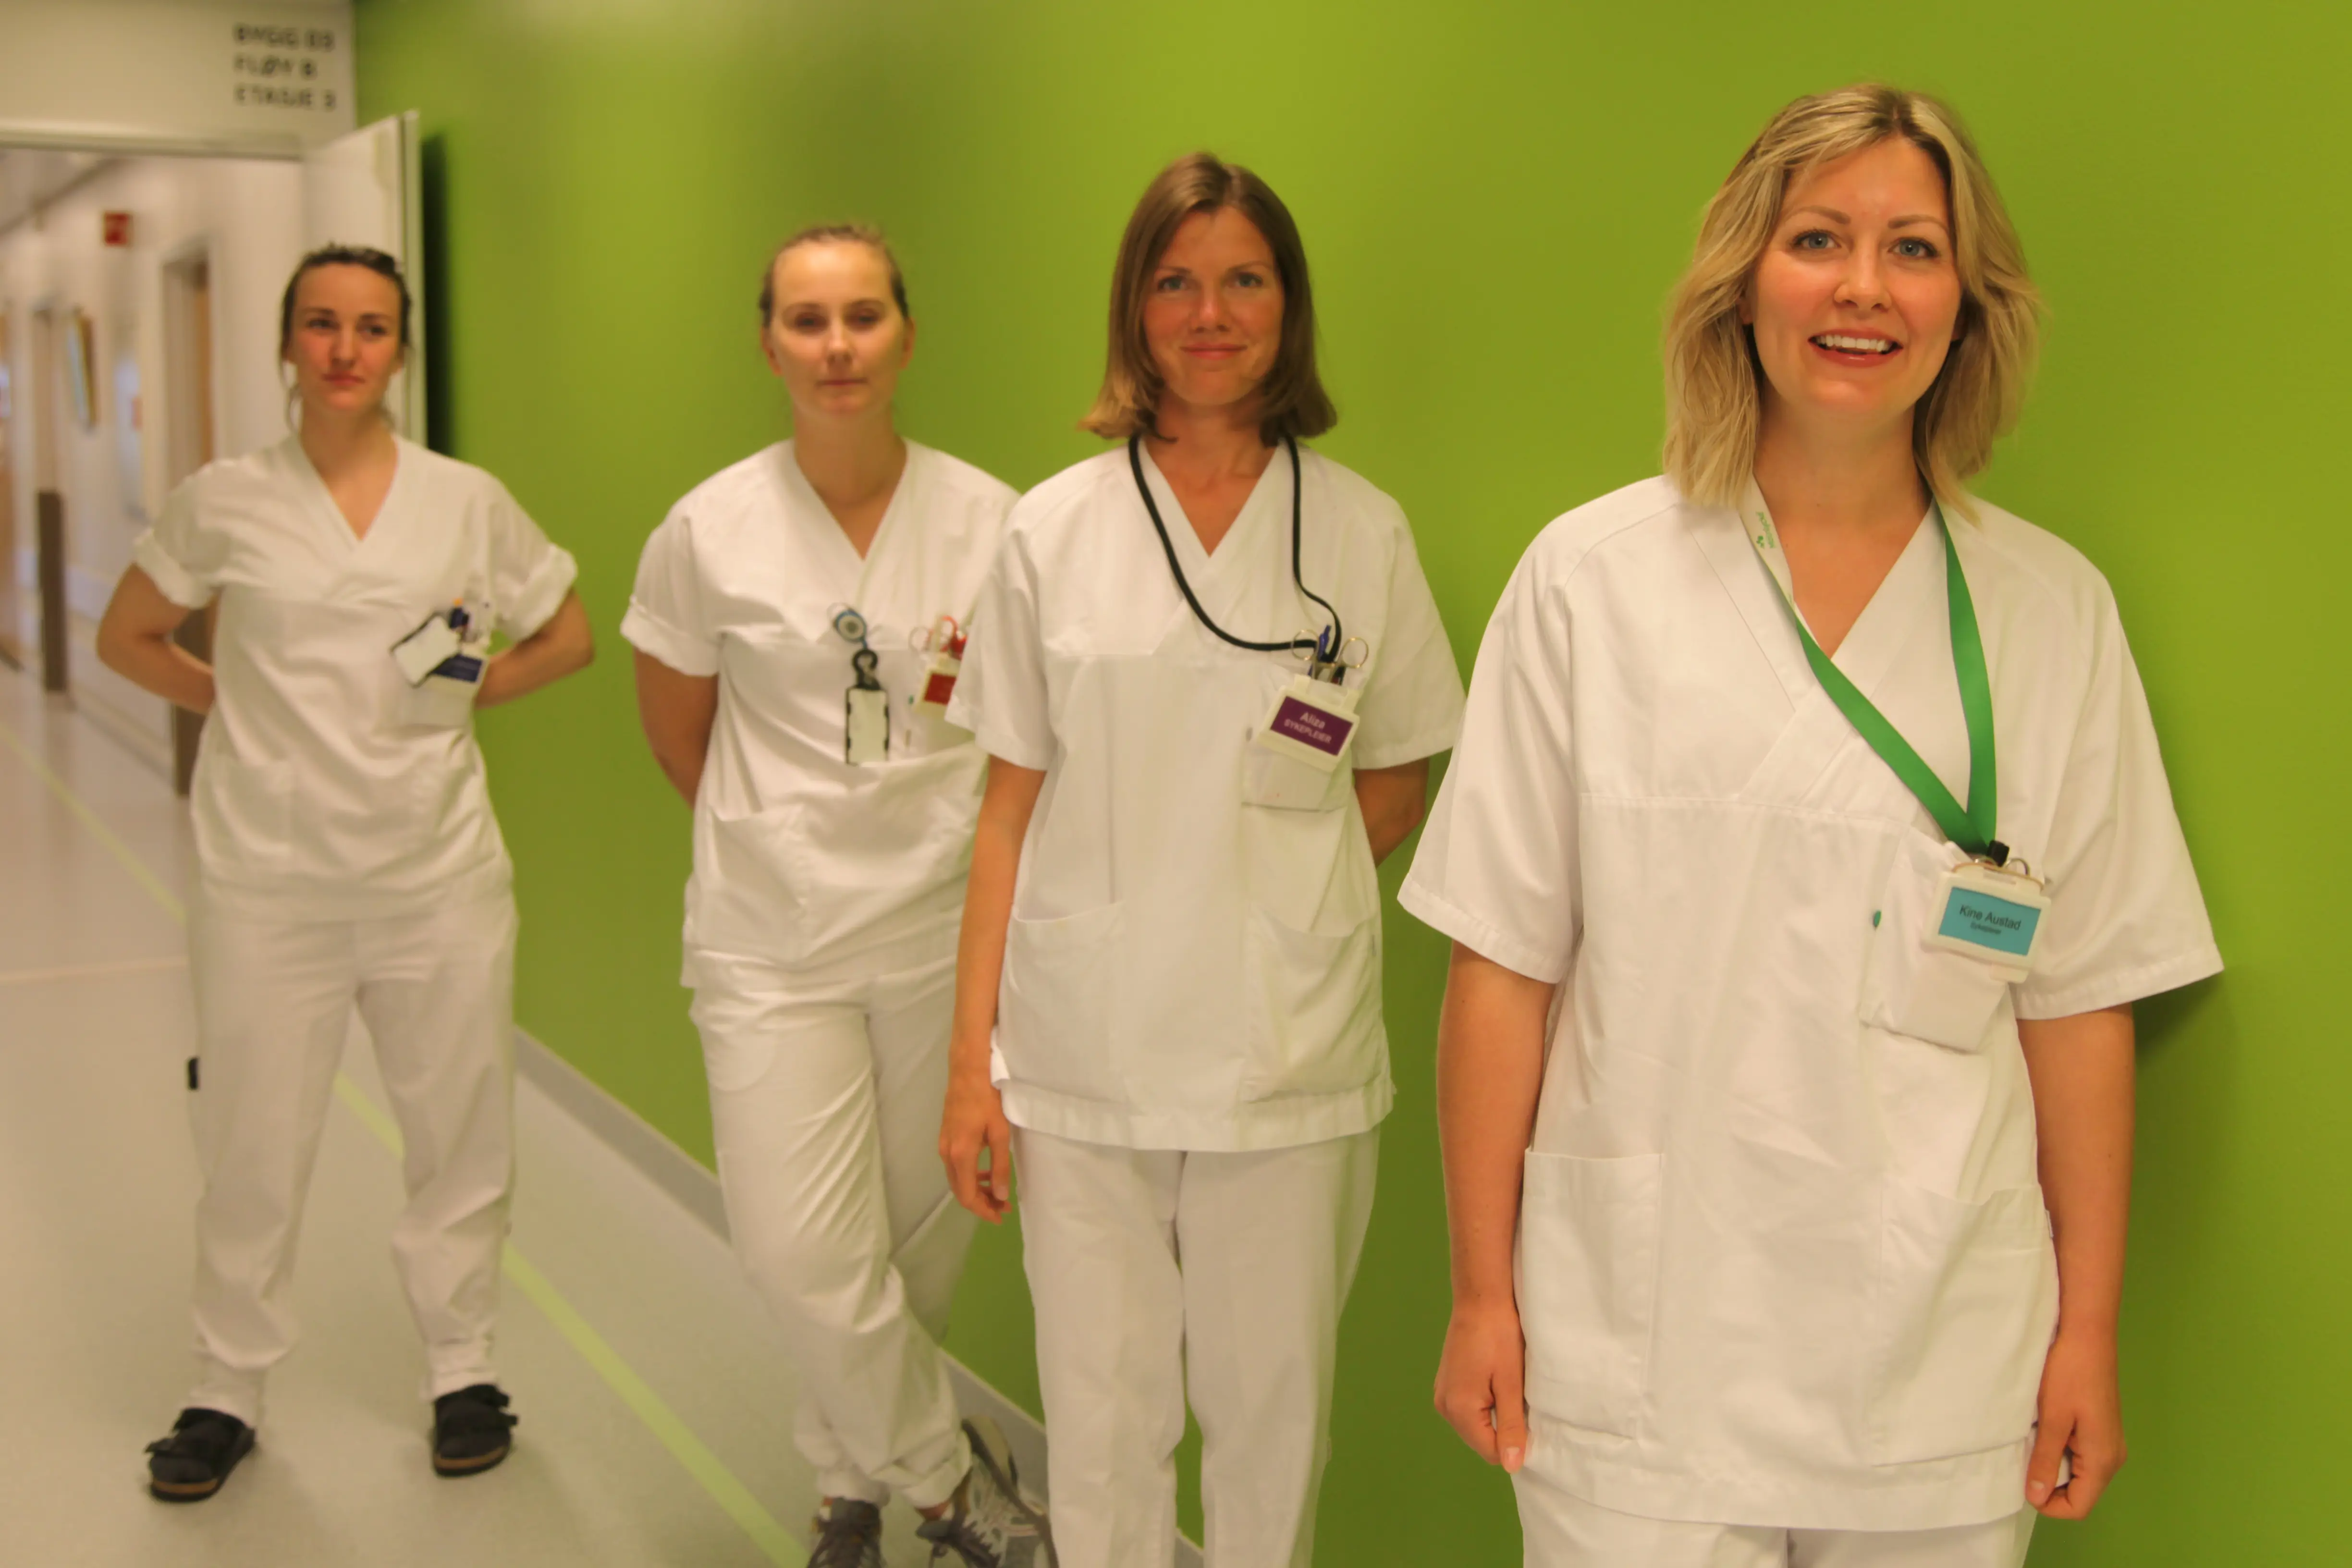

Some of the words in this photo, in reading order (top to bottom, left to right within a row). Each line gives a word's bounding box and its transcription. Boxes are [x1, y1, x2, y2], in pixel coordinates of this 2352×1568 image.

[234, 24, 299, 49] BYGG
[234, 54, 294, 77] FLØY
[235, 84, 316, 110] ETASJE
[320, 90, 336, 111] 3
[1960, 904, 1983, 921] Kine
[1984, 911, 2021, 931] Austad
